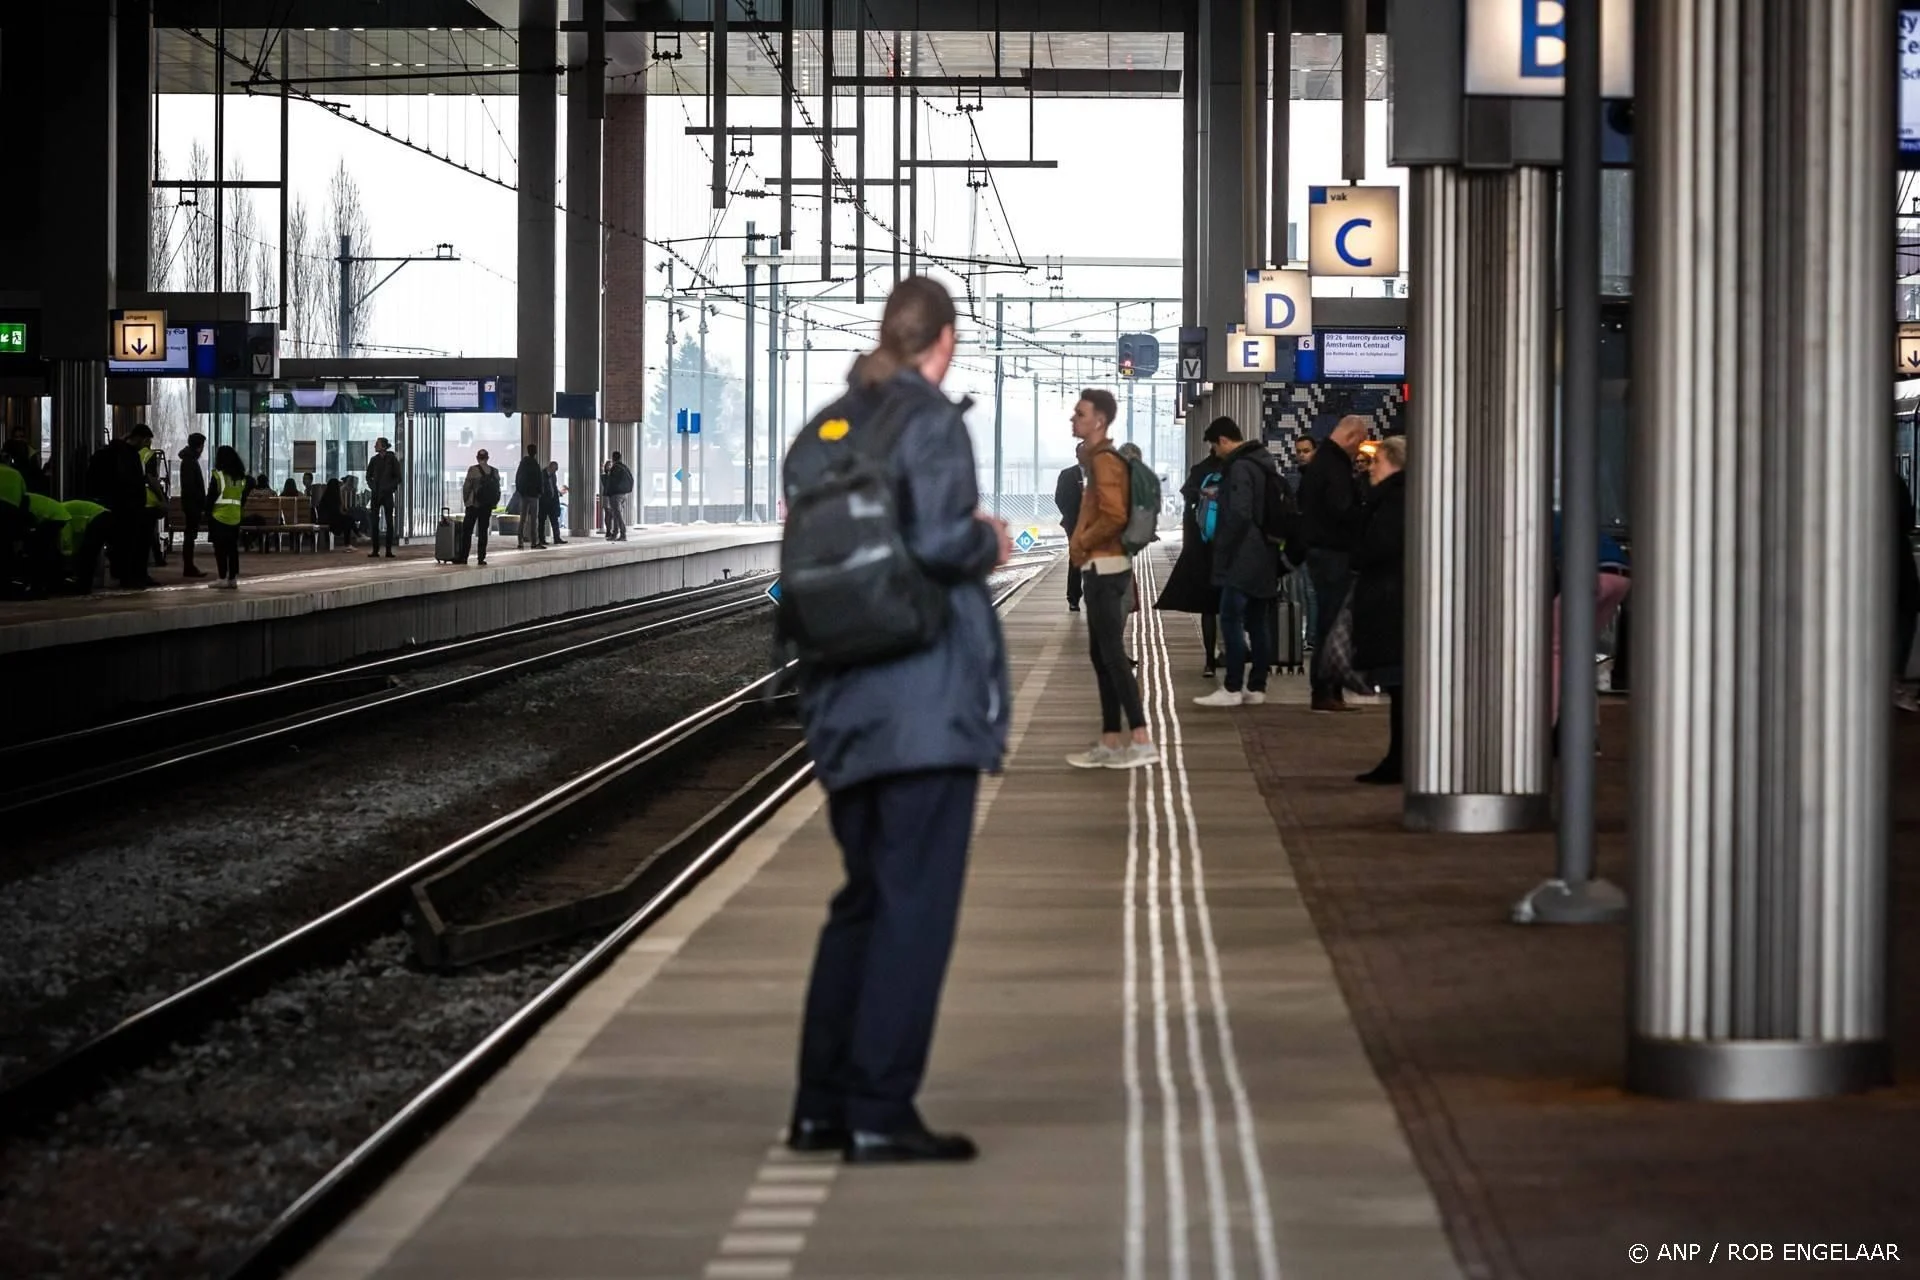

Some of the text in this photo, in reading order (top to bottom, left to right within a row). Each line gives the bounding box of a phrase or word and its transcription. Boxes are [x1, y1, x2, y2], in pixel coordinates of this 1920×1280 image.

[1521, 0, 1566, 77] B
[1331, 193, 1347, 201] vak
[1335, 218, 1372, 267] C
[1265, 293, 1296, 329] D
[203, 334, 208, 343] 7
[1303, 340, 1310, 348] 6
[1346, 334, 1371, 342] Intercity
[1243, 341, 1259, 367] E
[256, 356, 269, 372] V
[1185, 361, 1199, 377] V
[1020, 536, 1031, 545] 10
